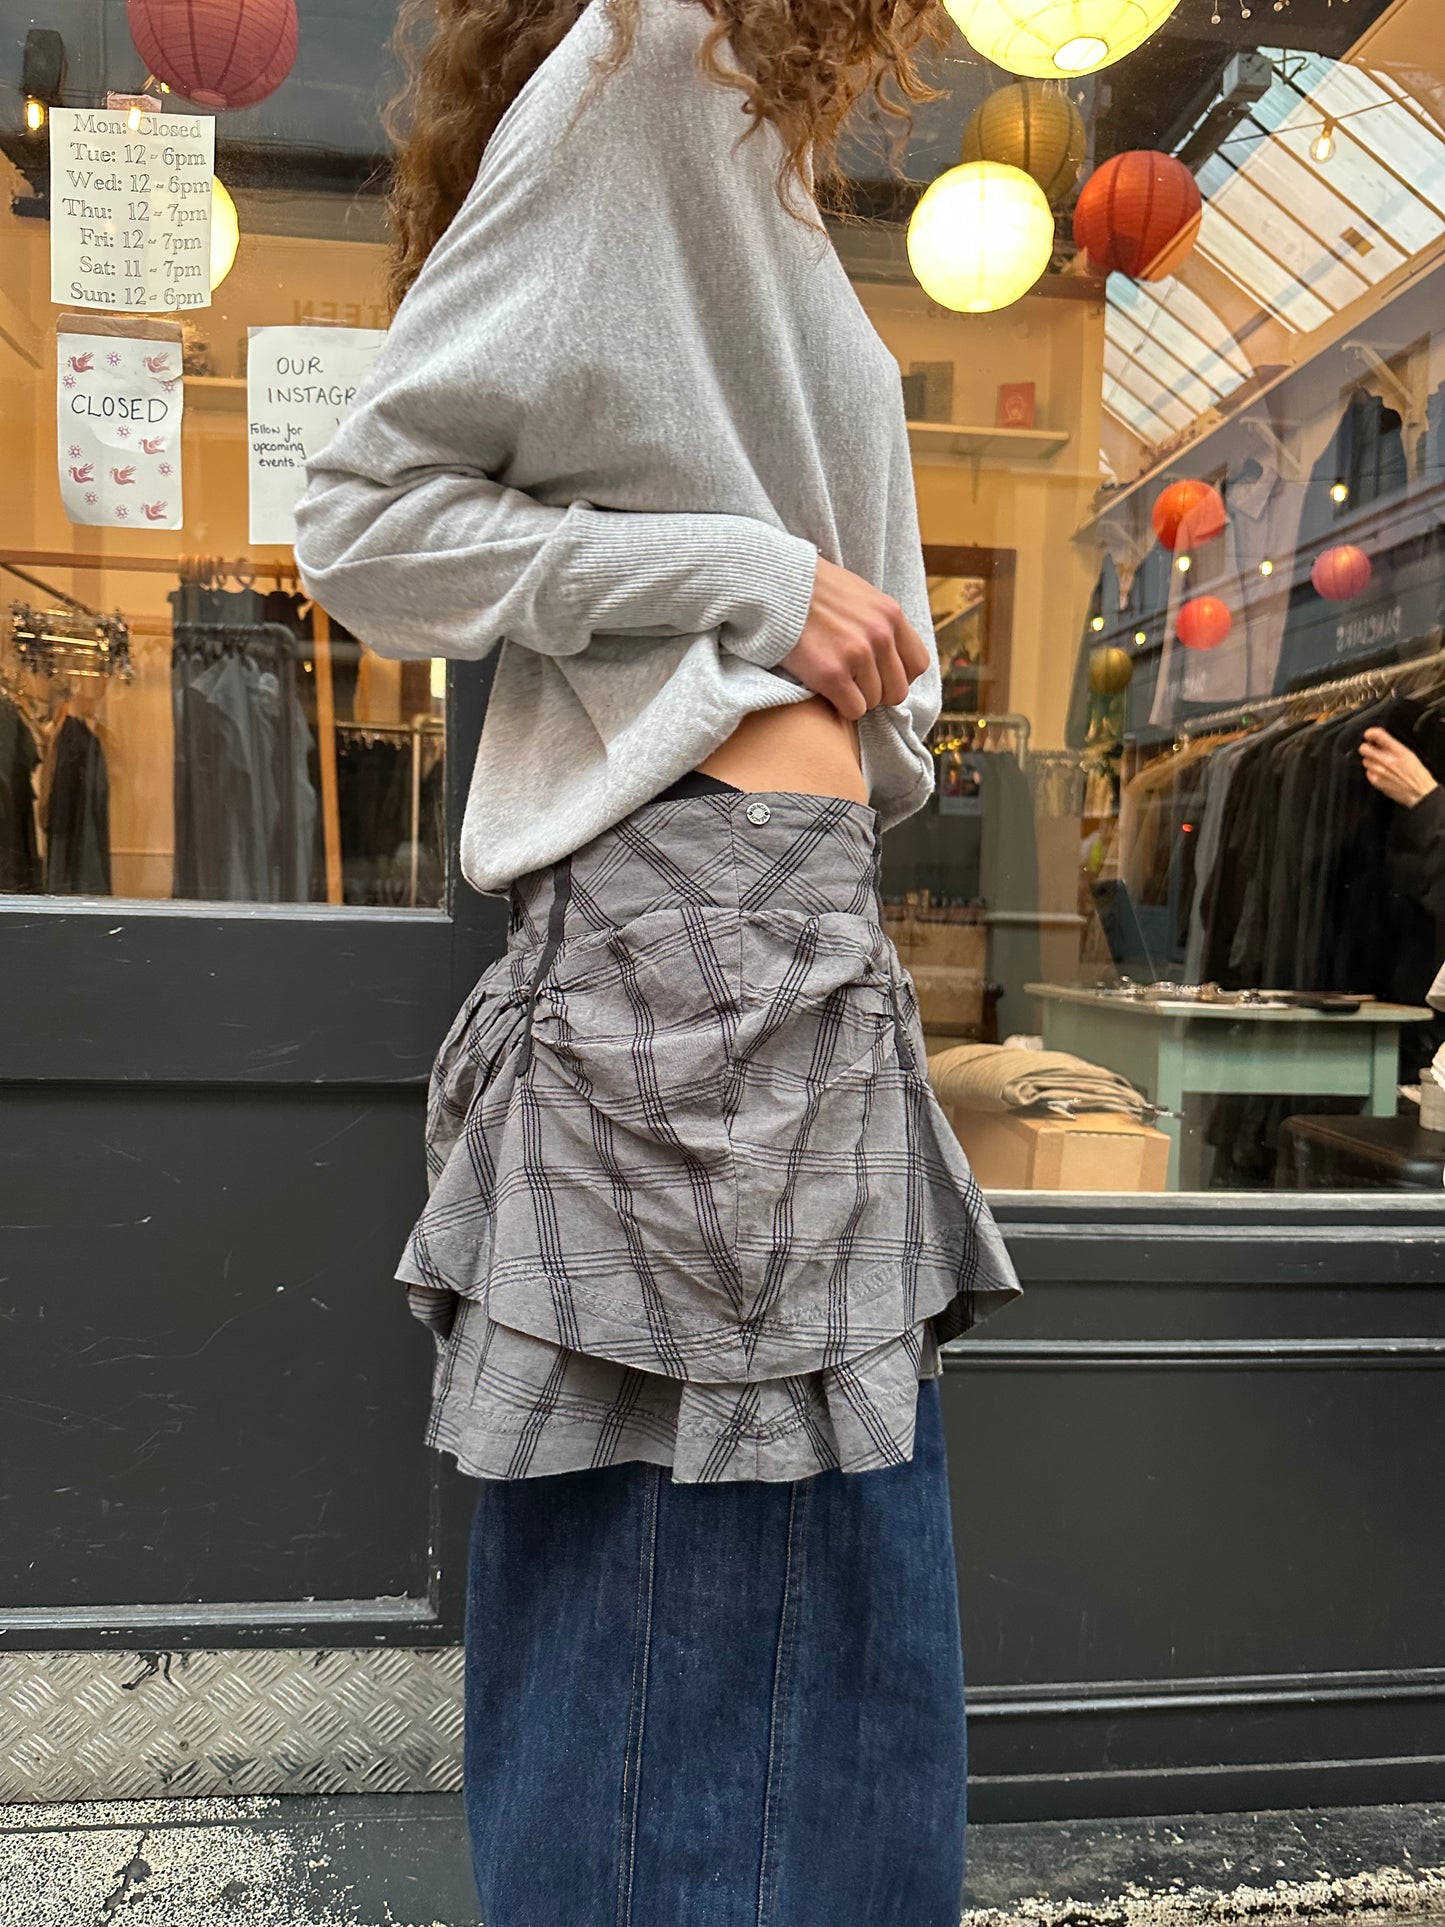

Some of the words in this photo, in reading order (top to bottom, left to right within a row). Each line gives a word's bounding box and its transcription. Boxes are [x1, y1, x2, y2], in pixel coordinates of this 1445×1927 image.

[73, 113, 127, 134] Mon:
[137, 116, 202, 139] Closed
[69, 142, 116, 163] Tue:
[124, 144, 147, 165] 12
[162, 147, 206, 170] 6pm
[66, 169, 122, 191] Wed:
[130, 173, 151, 193] 12
[167, 175, 211, 199] 6pm
[61, 198, 112, 220] Thu:
[127, 201, 150, 221] 12
[167, 203, 208, 227] 7pm
[79, 227, 114, 247] Fri:
[122, 229, 145, 249] 12
[162, 232, 202, 255] 7pm
[79, 255, 116, 276] Sat:
[124, 259, 142, 277] 11
[162, 260, 202, 282] 7pm
[70, 281, 116, 303] Sun:
[124, 286, 147, 305] 12
[163, 287, 204, 310] 6pm
[276, 356, 324, 376] OUR
[70, 394, 169, 423] CLOSED
[267, 385, 357, 406] INSTAGR
[250, 422, 281, 435] Follow
[284, 423, 303, 443] for
[253, 442, 307, 461] upcoming
